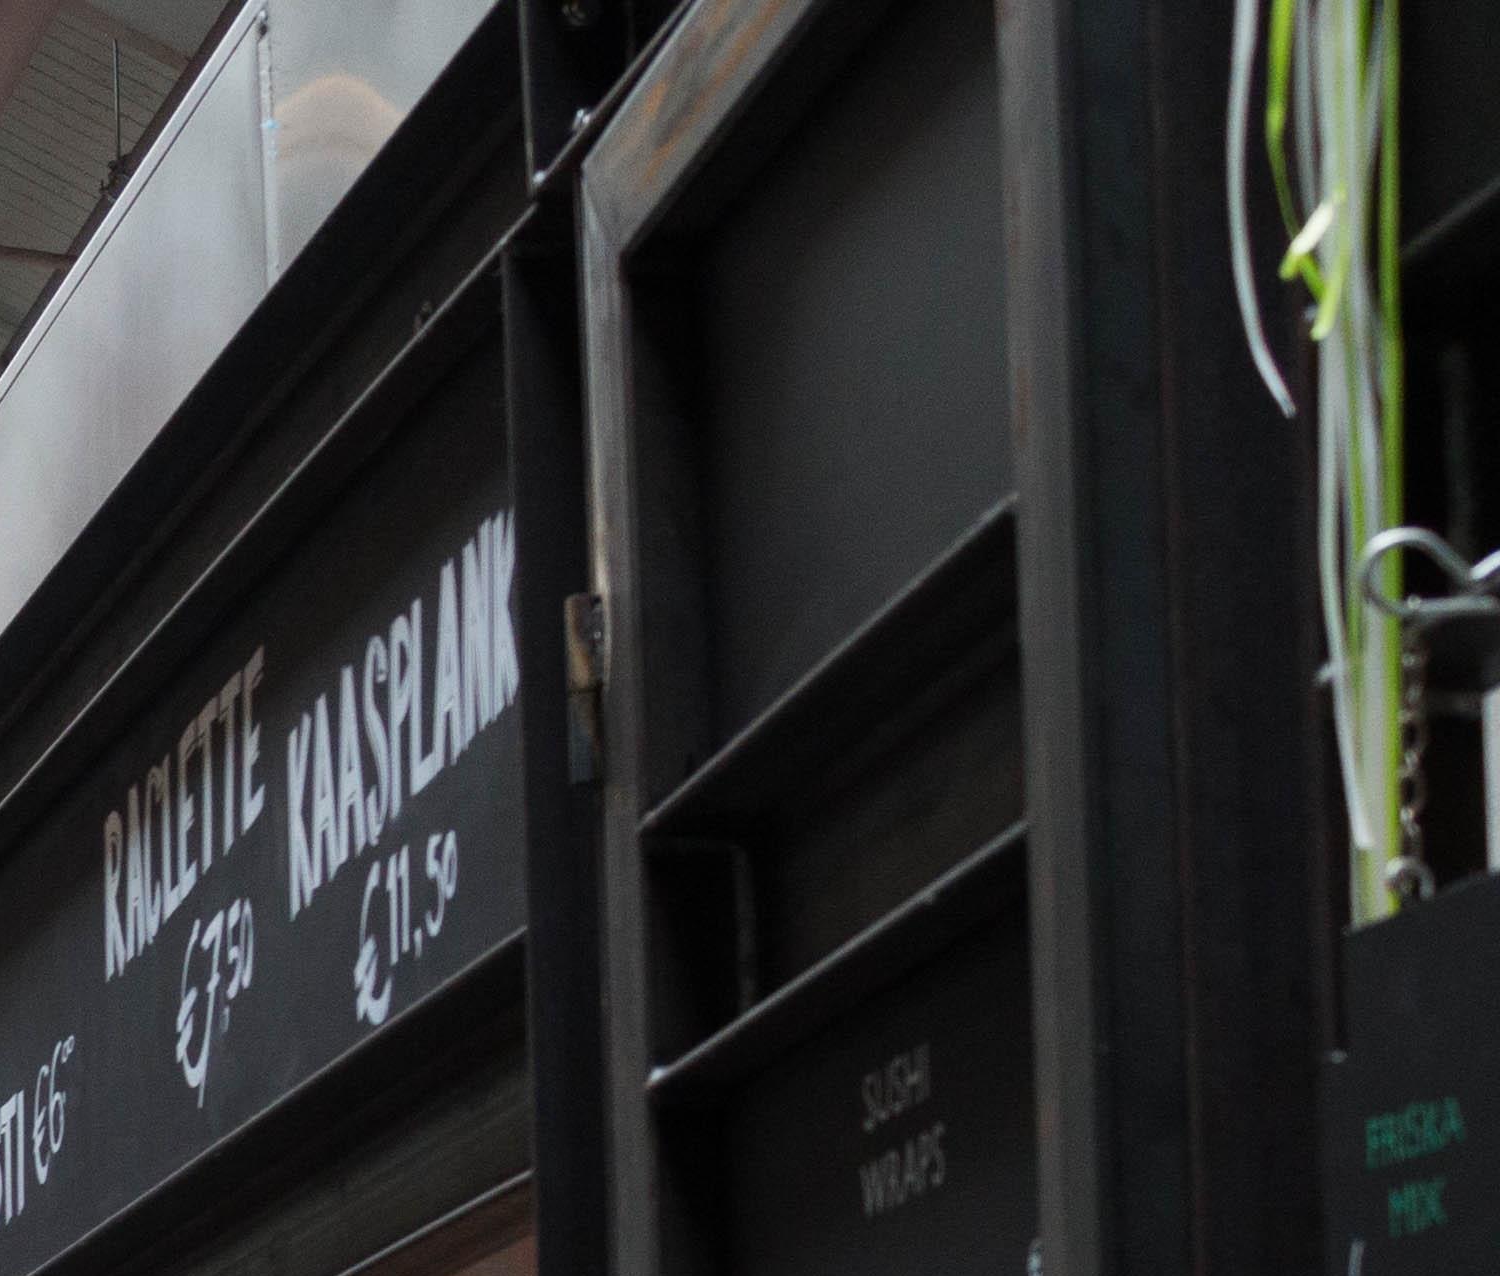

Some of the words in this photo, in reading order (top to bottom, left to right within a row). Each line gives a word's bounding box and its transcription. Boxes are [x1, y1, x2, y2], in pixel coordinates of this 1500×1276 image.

[104, 644, 266, 983] RACLETTE
[287, 506, 520, 922] KAASPLANK
[354, 829, 459, 1025] €11,50
